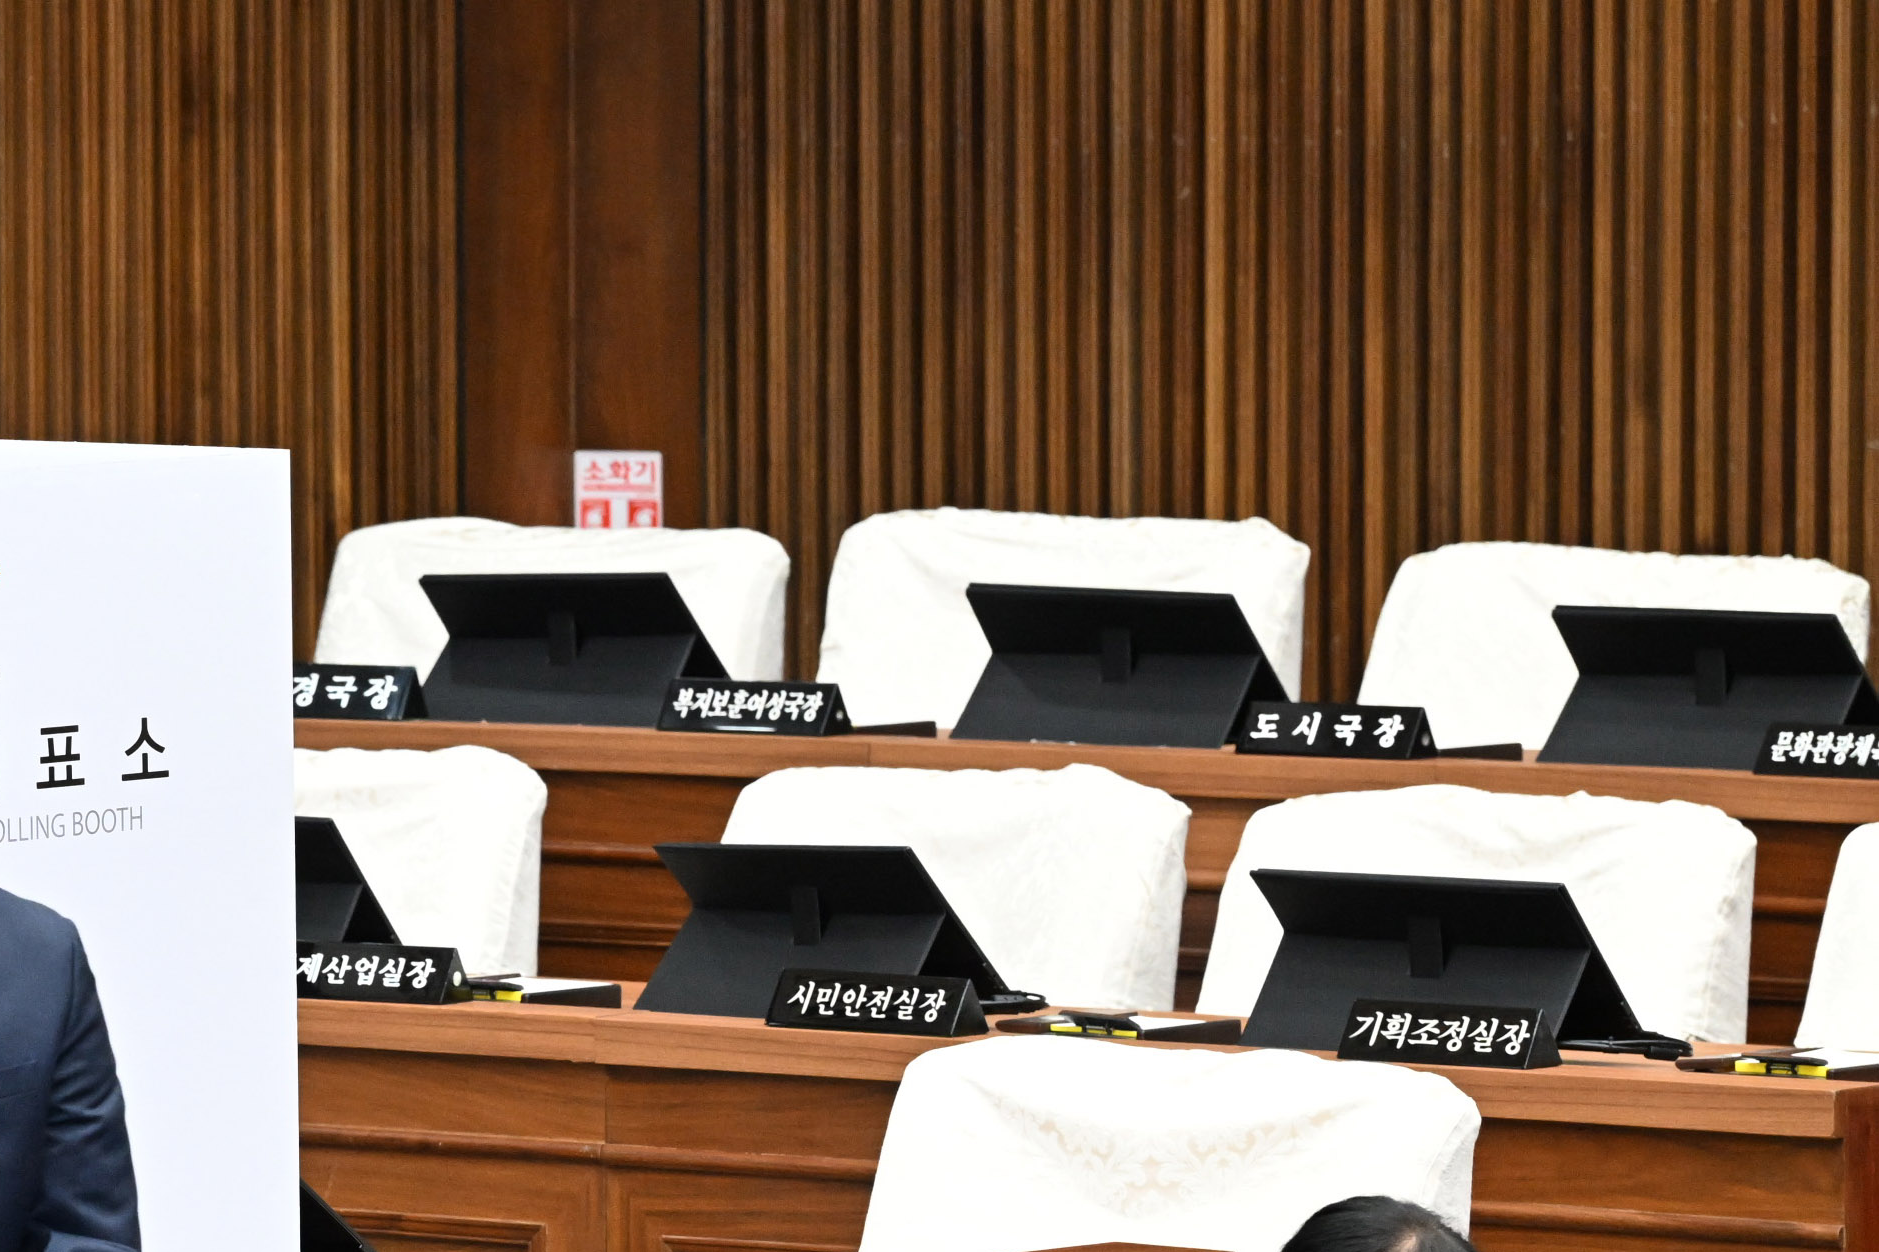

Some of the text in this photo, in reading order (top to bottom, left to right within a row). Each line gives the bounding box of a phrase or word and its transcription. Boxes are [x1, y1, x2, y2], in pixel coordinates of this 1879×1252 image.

[584, 460, 656, 482] 소화기
[1249, 712, 1405, 748] 도시국장
[72, 806, 144, 837] BOOTH
[787, 981, 947, 1023] 시민안전실장
[1348, 1011, 1531, 1056] 기획조정실장
